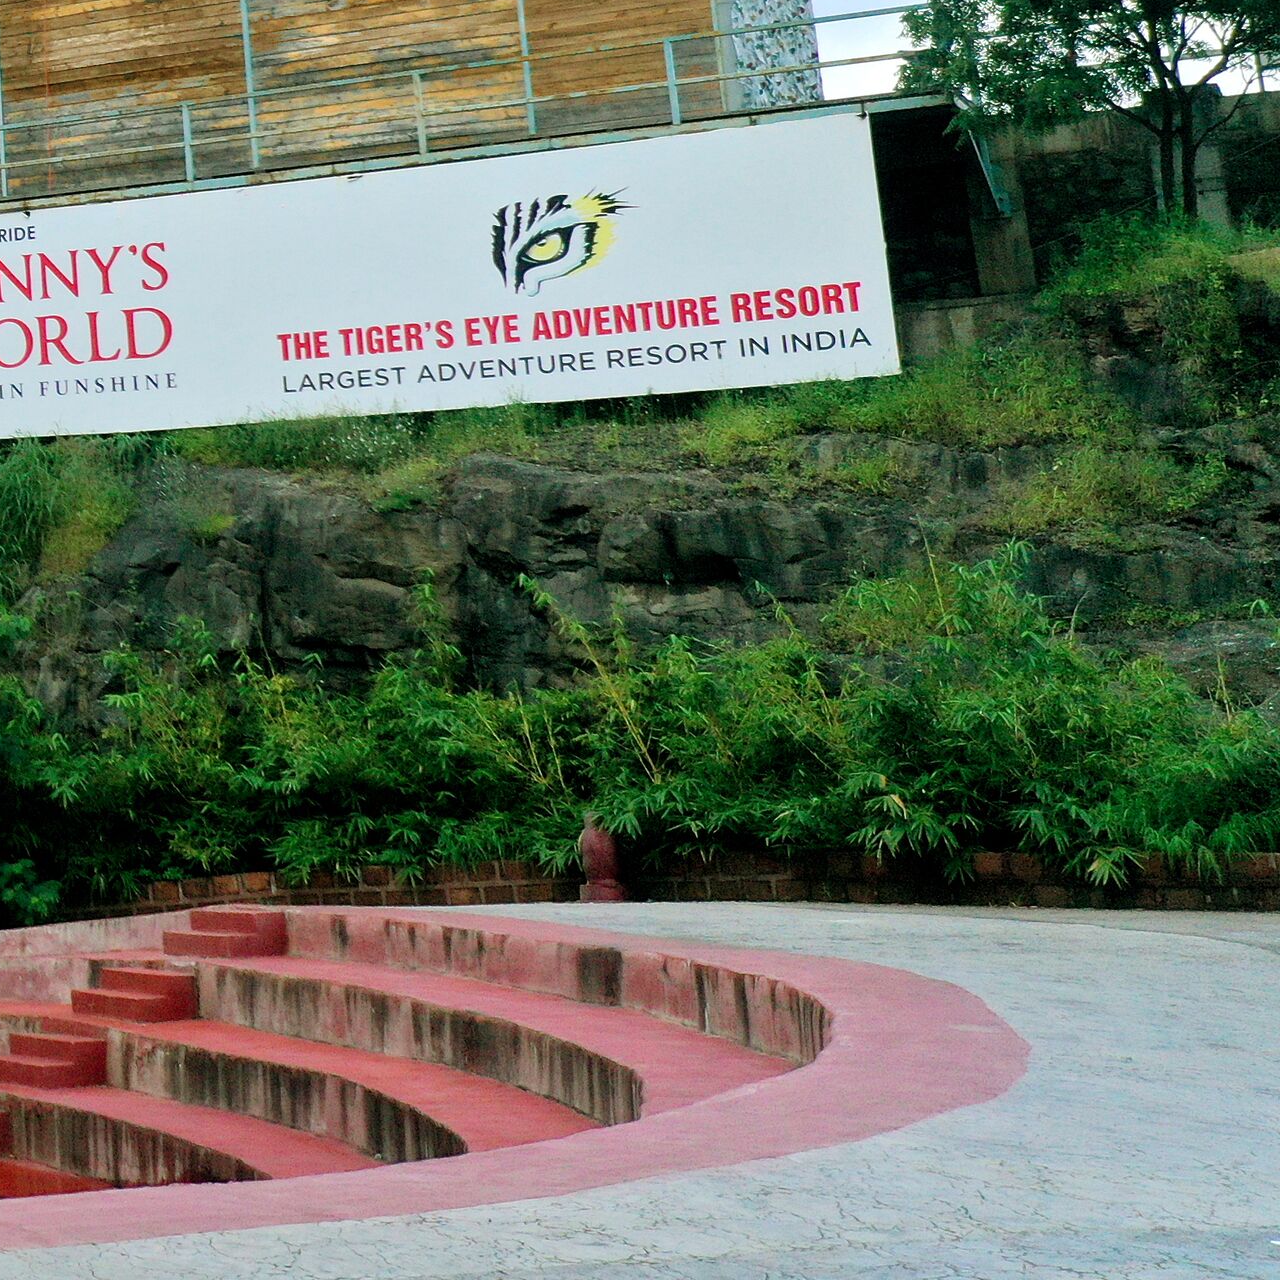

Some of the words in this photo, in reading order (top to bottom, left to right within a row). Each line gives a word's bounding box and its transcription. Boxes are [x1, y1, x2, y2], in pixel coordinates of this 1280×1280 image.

[276, 330, 330, 362] THE
[338, 319, 455, 357] TIGER'S
[464, 313, 522, 347] EYE
[531, 295, 720, 342] ADVENTURE
[730, 281, 863, 325] RESORT
[38, 371, 179, 398] FUNSHINE
[281, 366, 407, 394] LARGEST
[417, 351, 598, 384] ADVENTURE
[605, 339, 729, 370] RESORT
[739, 336, 771, 358] IN
[781, 327, 874, 355] INDIA
